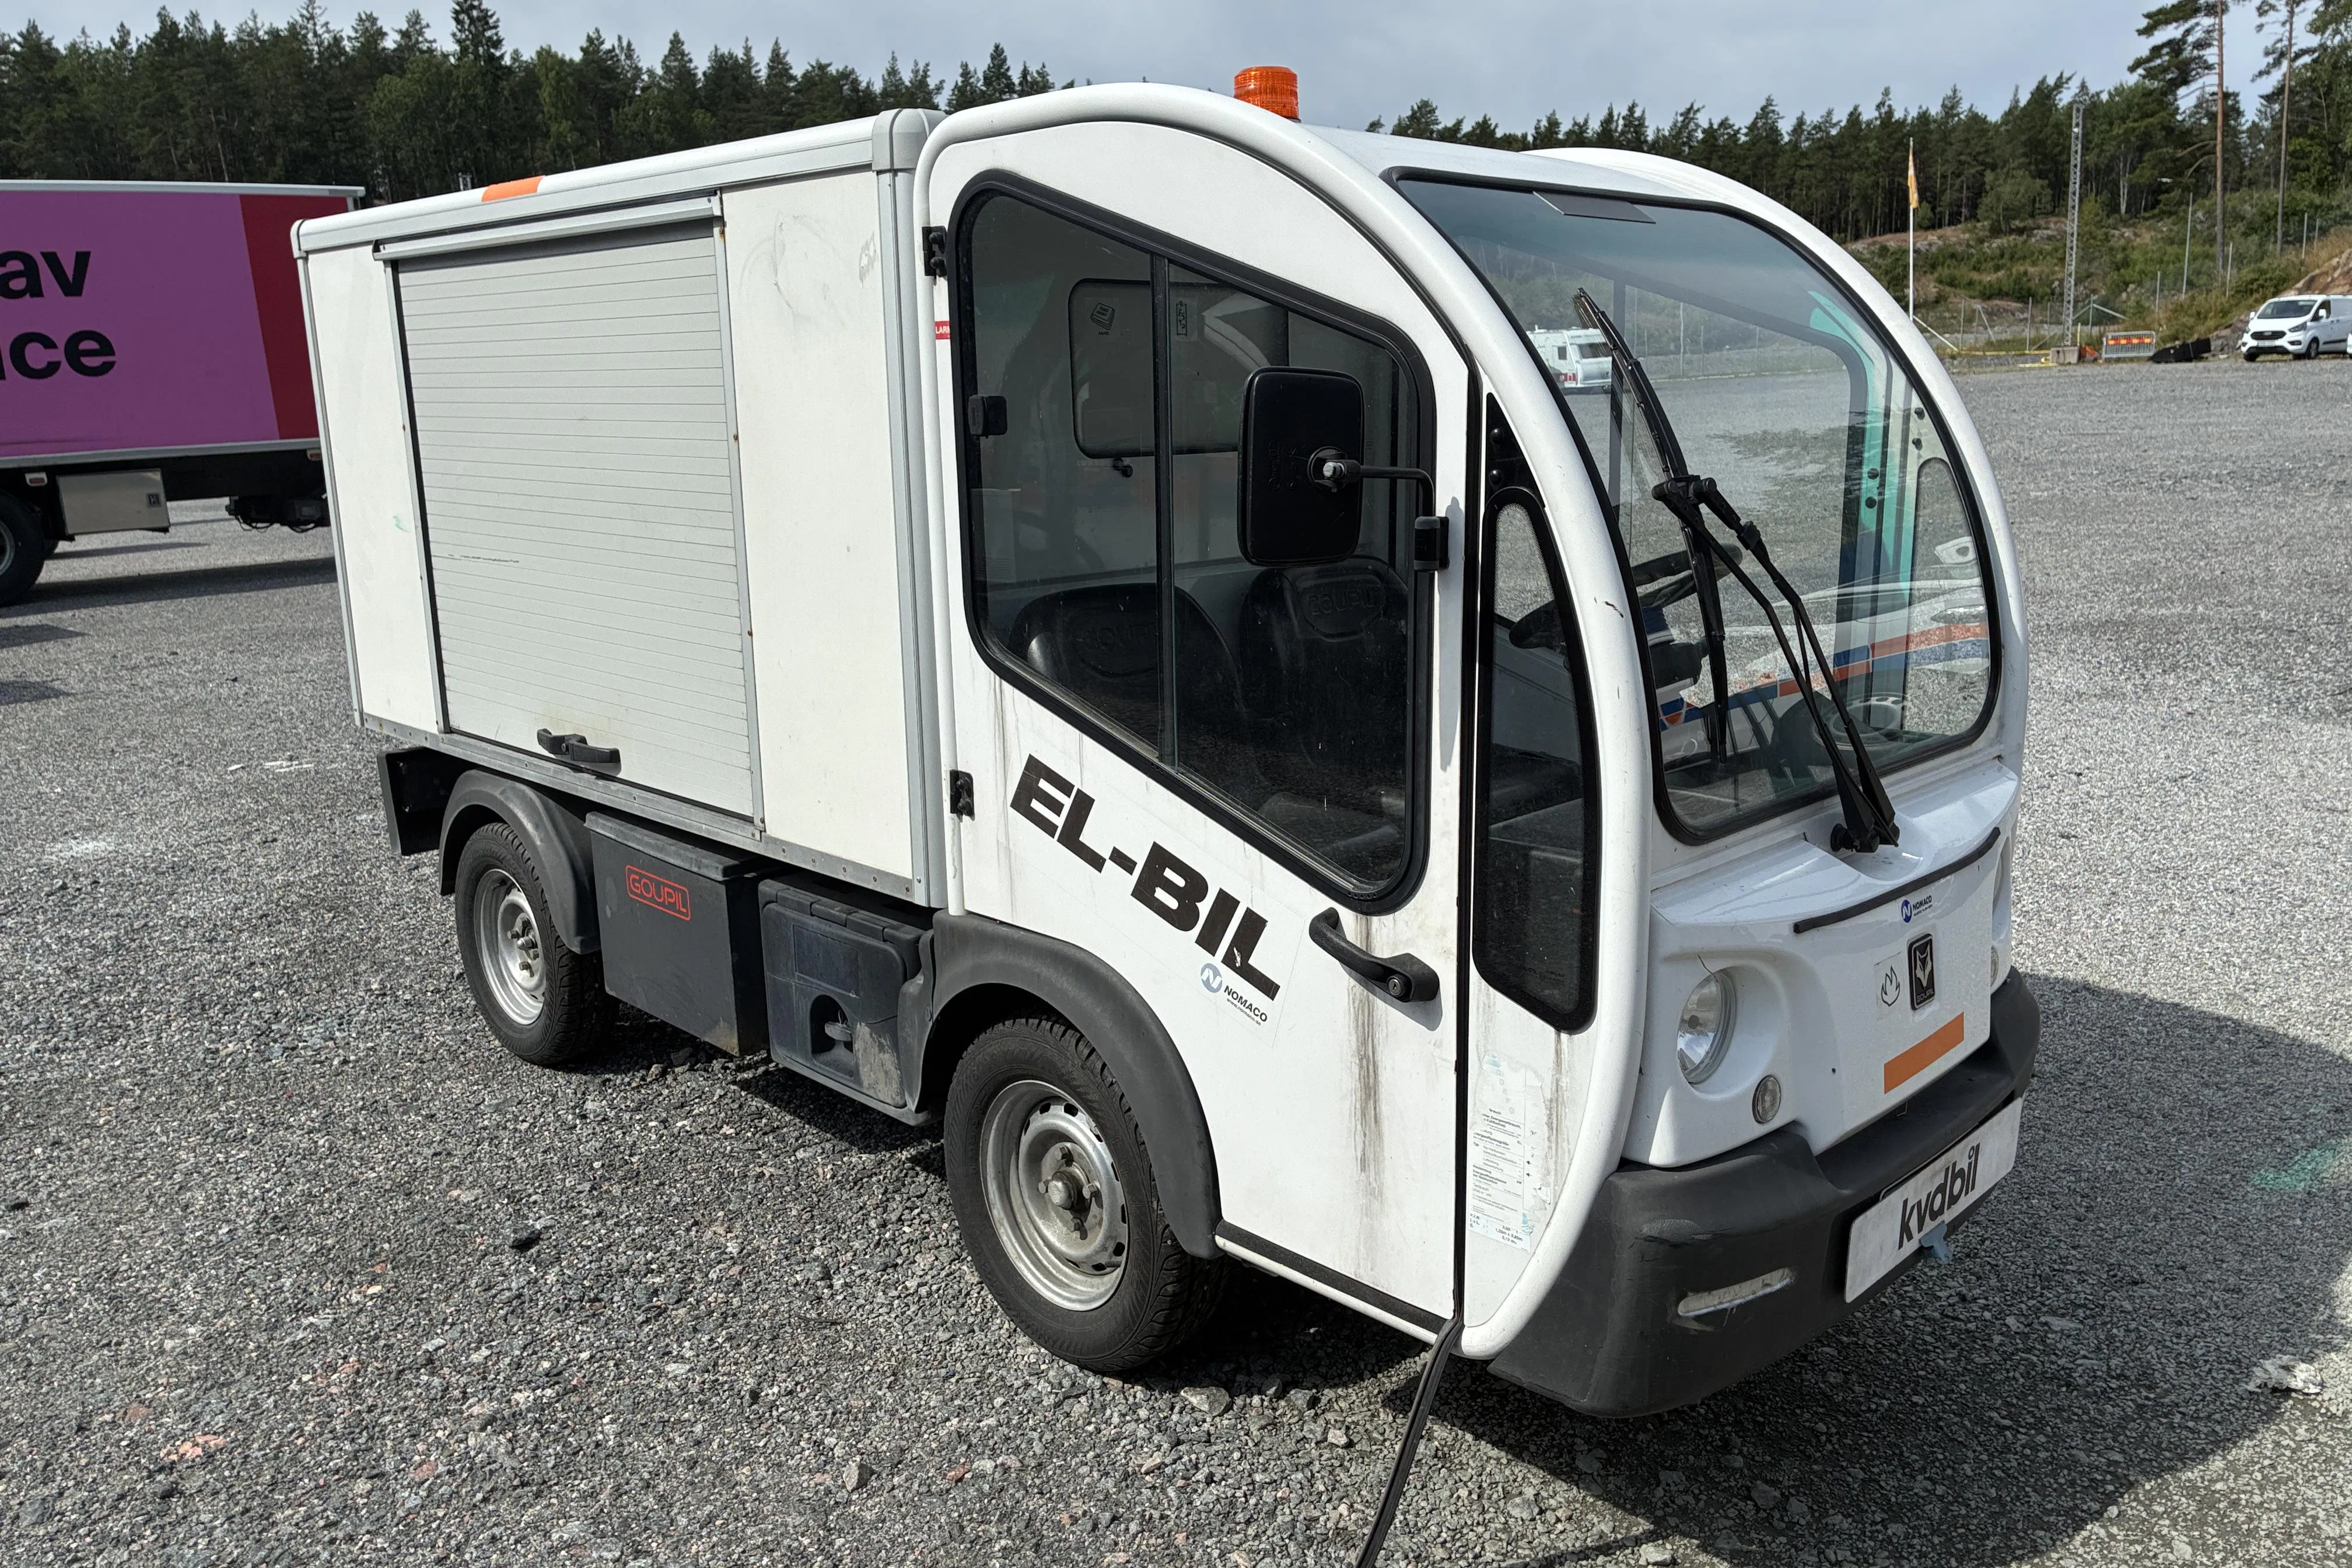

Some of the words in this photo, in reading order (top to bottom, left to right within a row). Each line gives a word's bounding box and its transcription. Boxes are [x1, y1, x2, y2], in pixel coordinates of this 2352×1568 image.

[0, 250, 91, 299] av
[0, 330, 117, 381] ce
[629, 874, 687, 912] GOUPIL
[1010, 753, 1280, 1001] EL-BIL
[1913, 896, 1932, 911] NOMACO
[1224, 985, 1268, 1022] NOMACO
[1898, 1142, 1981, 1250] kvdbil
